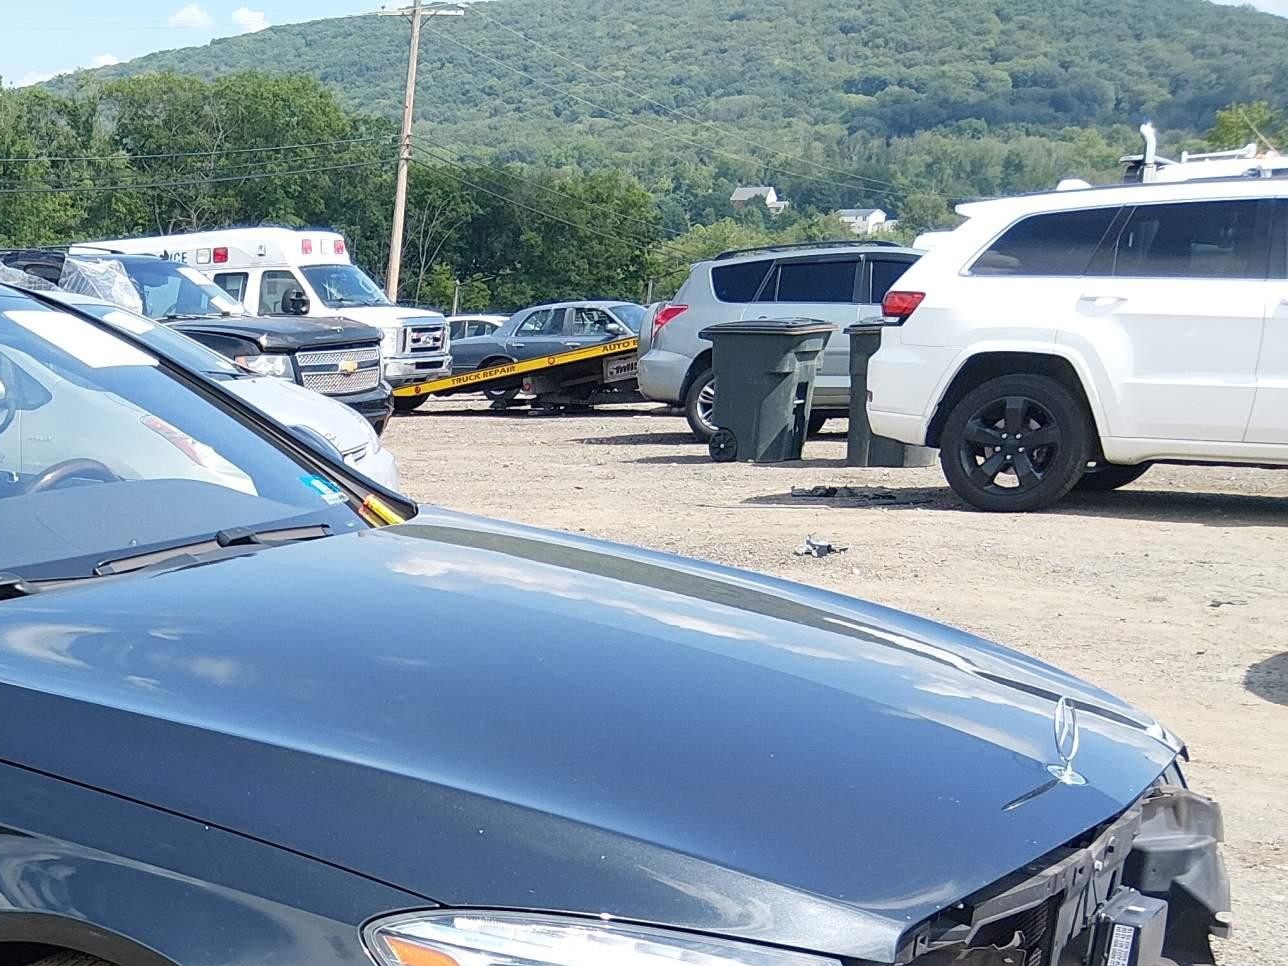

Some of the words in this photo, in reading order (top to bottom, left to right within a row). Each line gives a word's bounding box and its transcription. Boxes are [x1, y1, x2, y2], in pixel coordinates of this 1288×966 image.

[601, 341, 631, 353] AUTO
[451, 373, 481, 385] TRUCK
[482, 365, 516, 378] REPAIR
